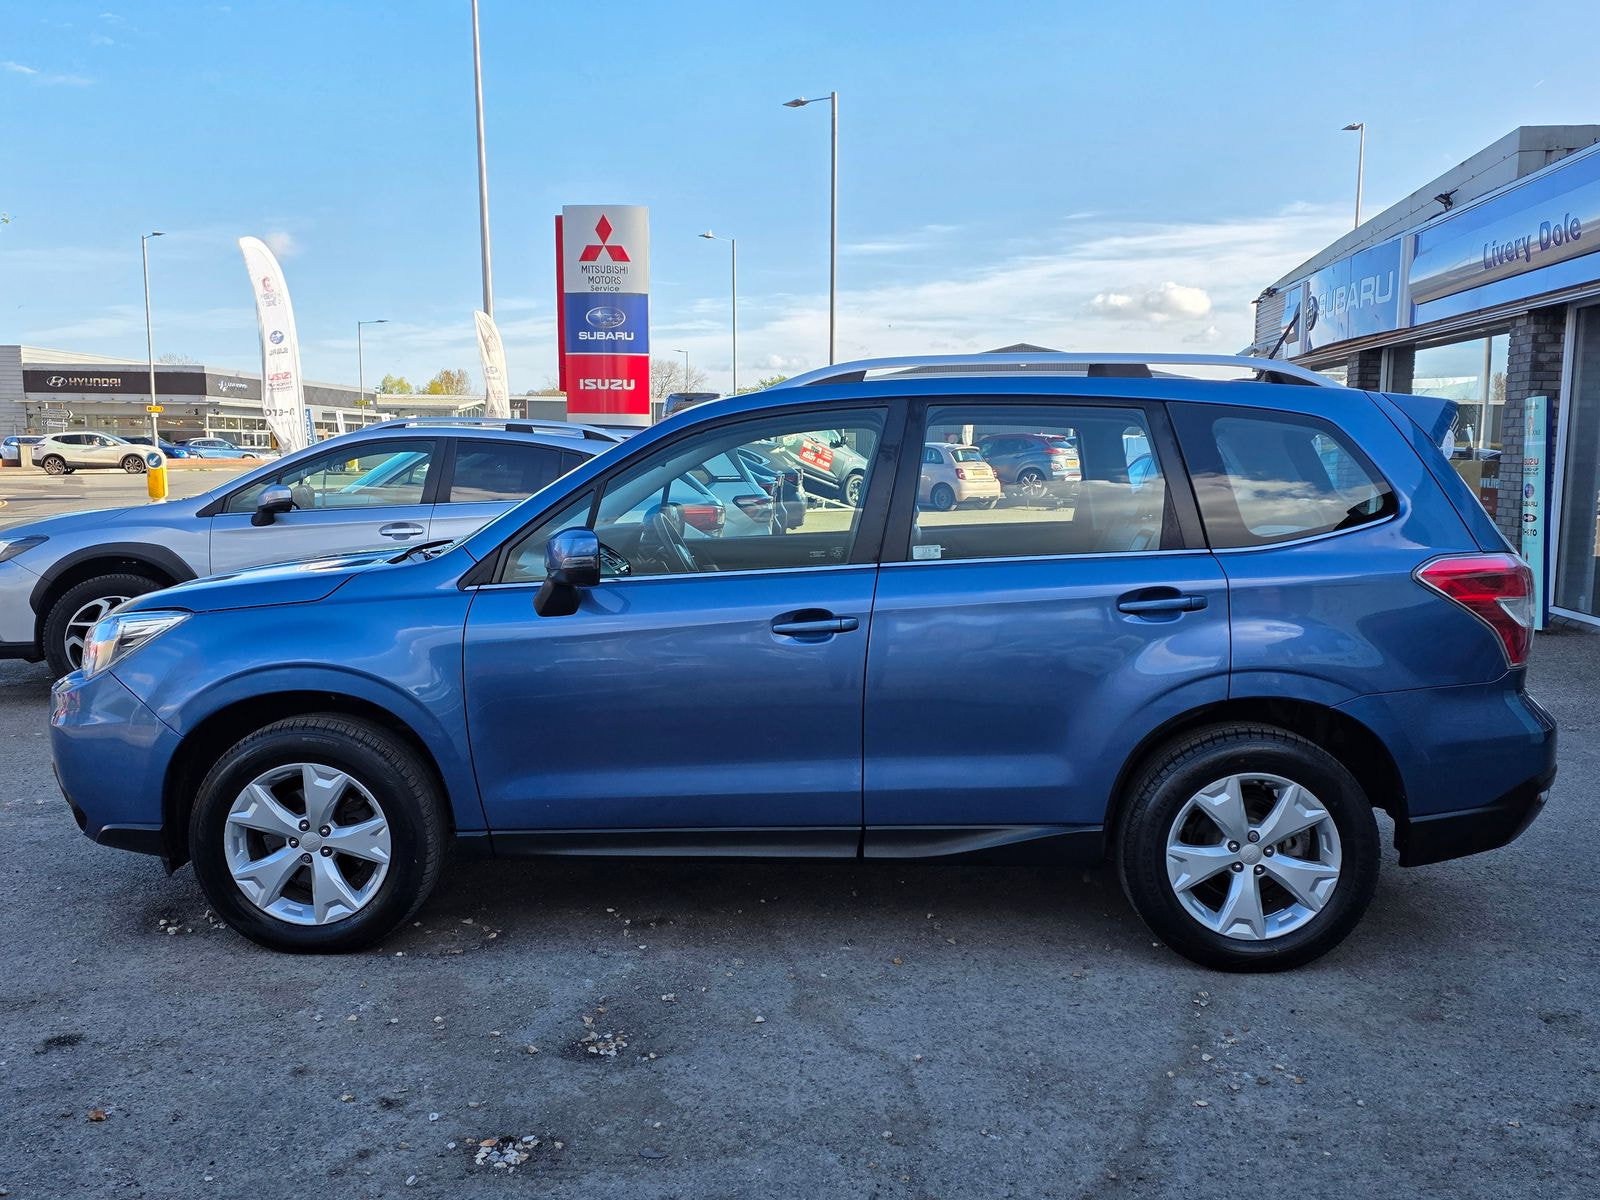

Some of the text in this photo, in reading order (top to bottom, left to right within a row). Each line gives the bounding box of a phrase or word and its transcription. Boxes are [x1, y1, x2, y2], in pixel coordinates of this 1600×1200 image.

[1483, 212, 1581, 269] Livery Dole
[581, 265, 629, 274] MITSUBISHI
[587, 275, 622, 285] MOTORS
[1318, 271, 1394, 320] SUBARU
[578, 331, 635, 341] SUBARU
[68, 377, 121, 387] HYUNDAI
[579, 378, 636, 390] ISUZU
